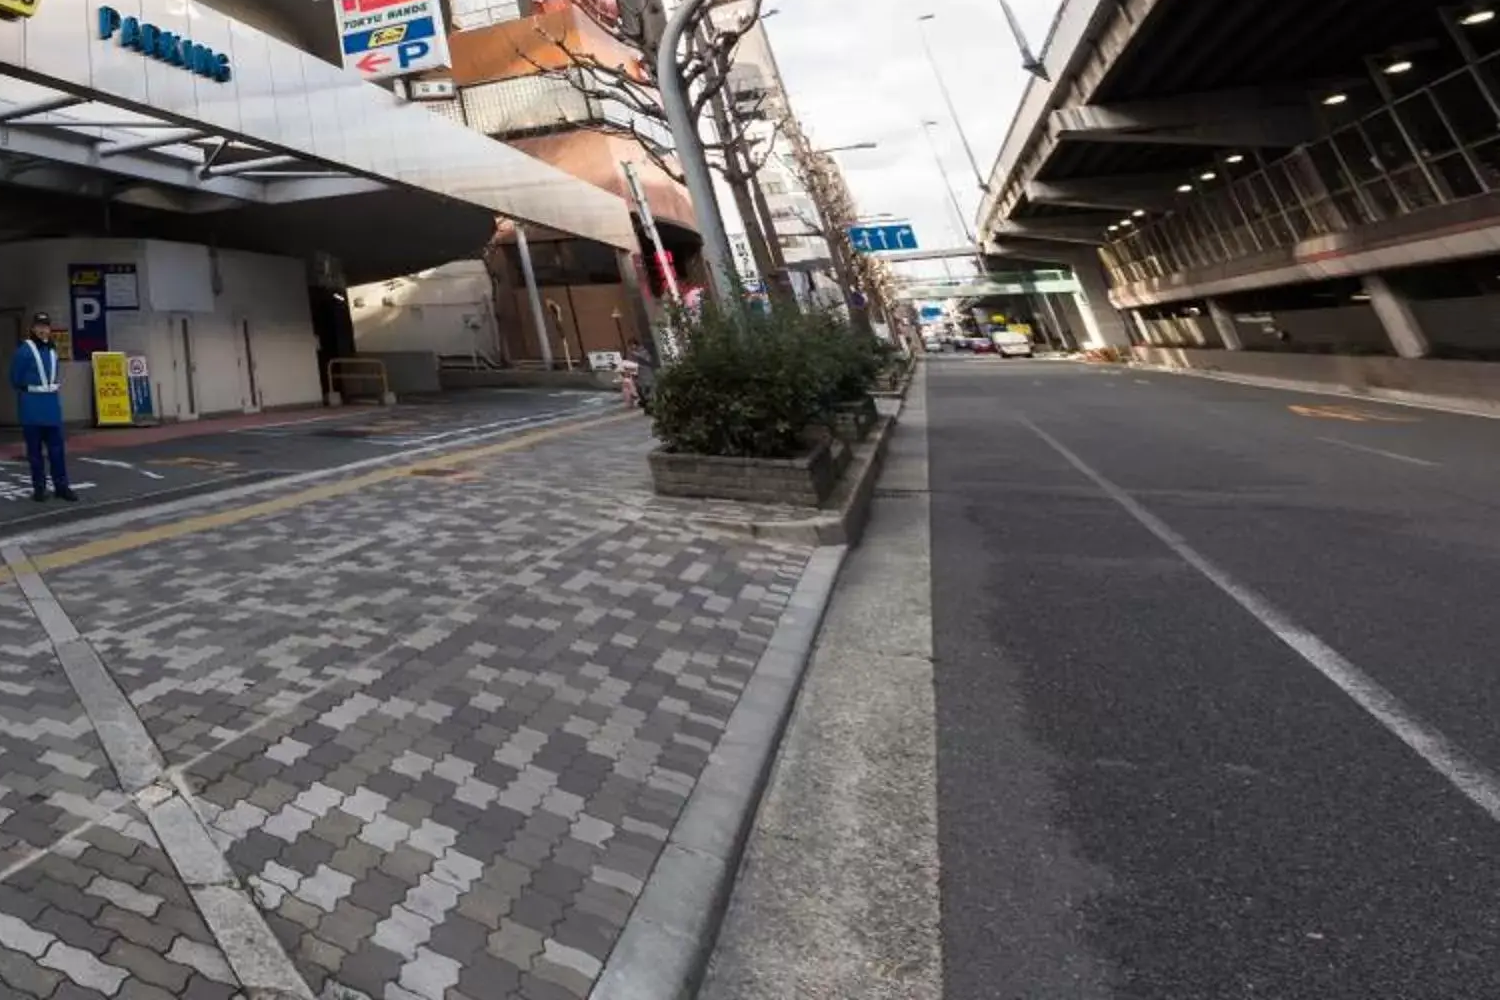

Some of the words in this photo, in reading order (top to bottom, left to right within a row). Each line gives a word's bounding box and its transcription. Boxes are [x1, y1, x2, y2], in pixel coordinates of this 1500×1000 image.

[344, 13, 383, 29] TOKYU
[387, 1, 428, 20] HANDS
[98, 6, 230, 82] PARKING
[398, 42, 430, 69] P
[75, 297, 102, 329] P
